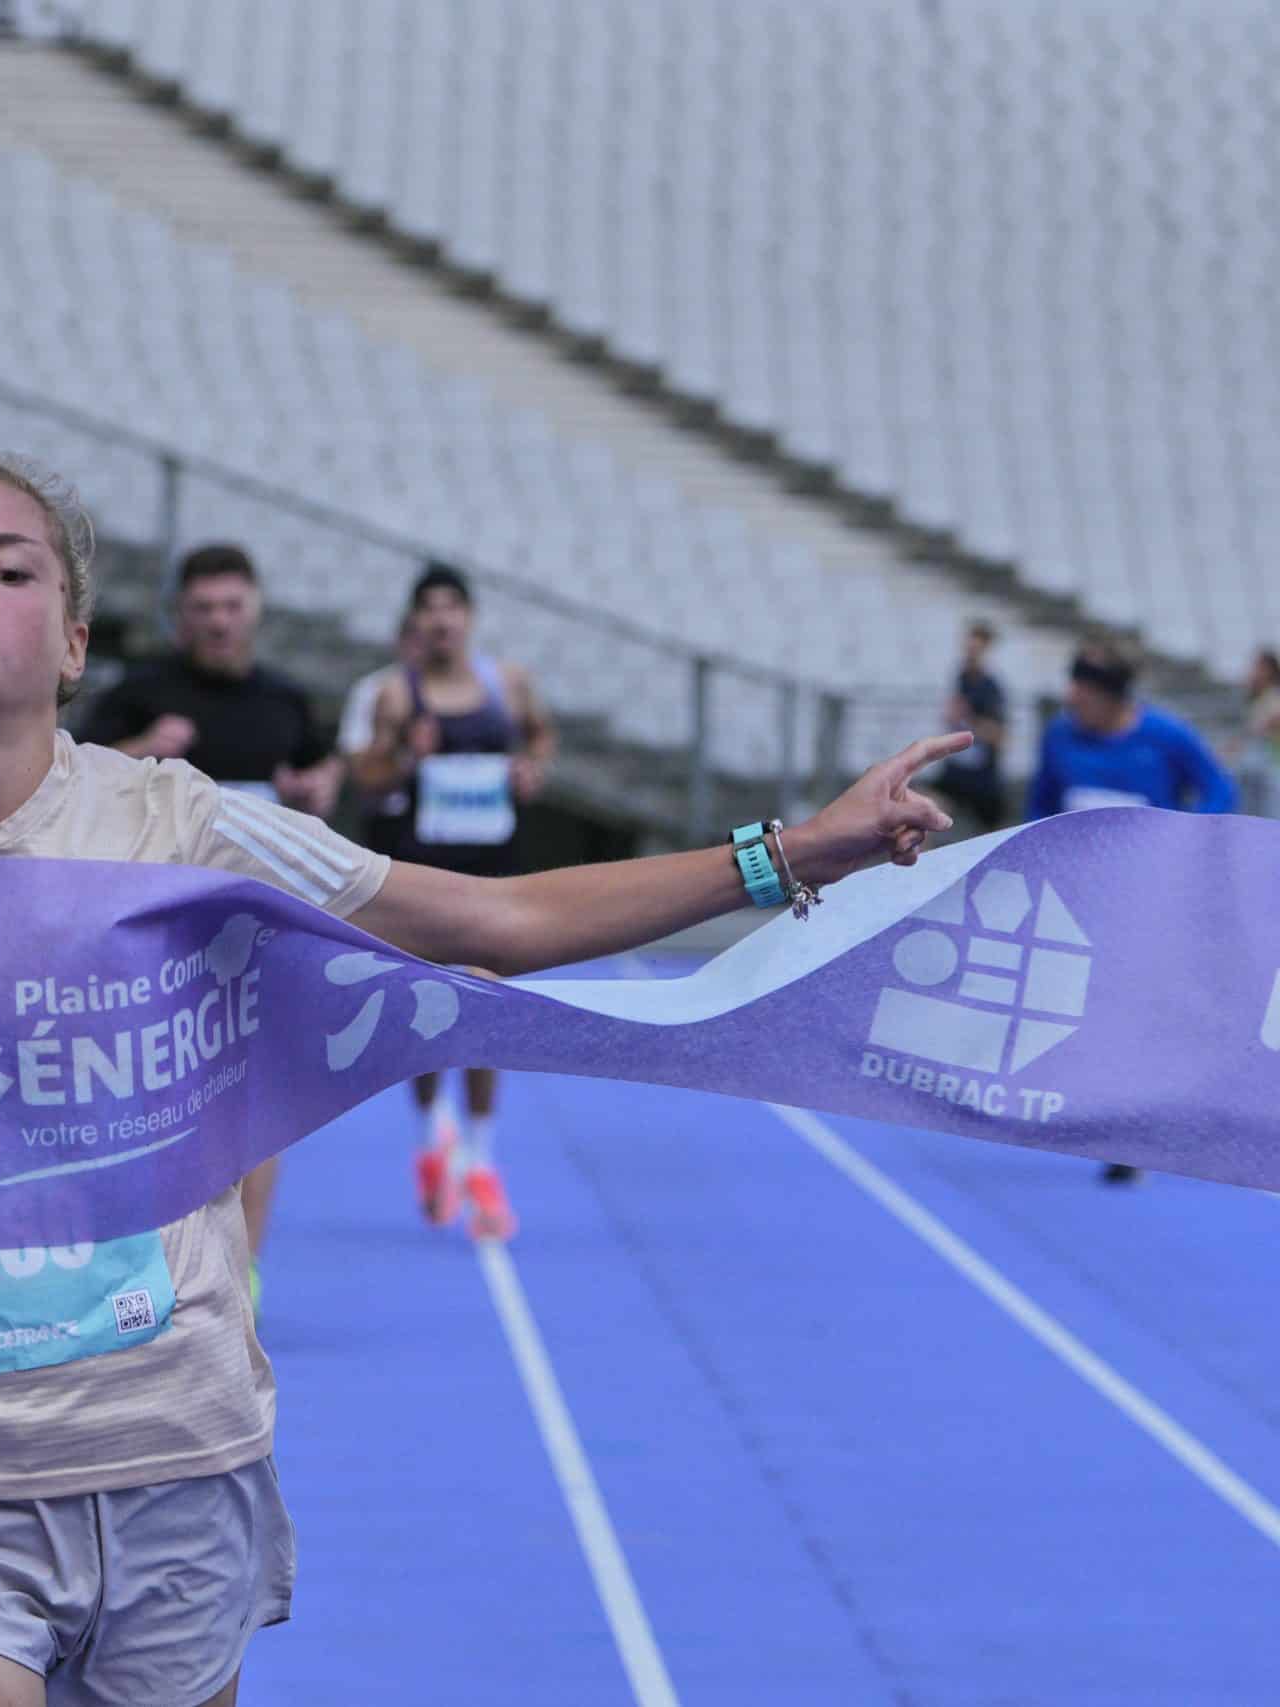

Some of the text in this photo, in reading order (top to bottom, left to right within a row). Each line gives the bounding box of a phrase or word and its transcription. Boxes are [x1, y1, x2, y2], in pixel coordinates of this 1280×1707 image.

[15, 927, 278, 1016] Plaine Come
[18, 968, 261, 1105] ÉNERGIE
[22, 1059, 248, 1148] votre réseau de chaleur
[860, 1052, 1065, 1124] DUBRAC TP
